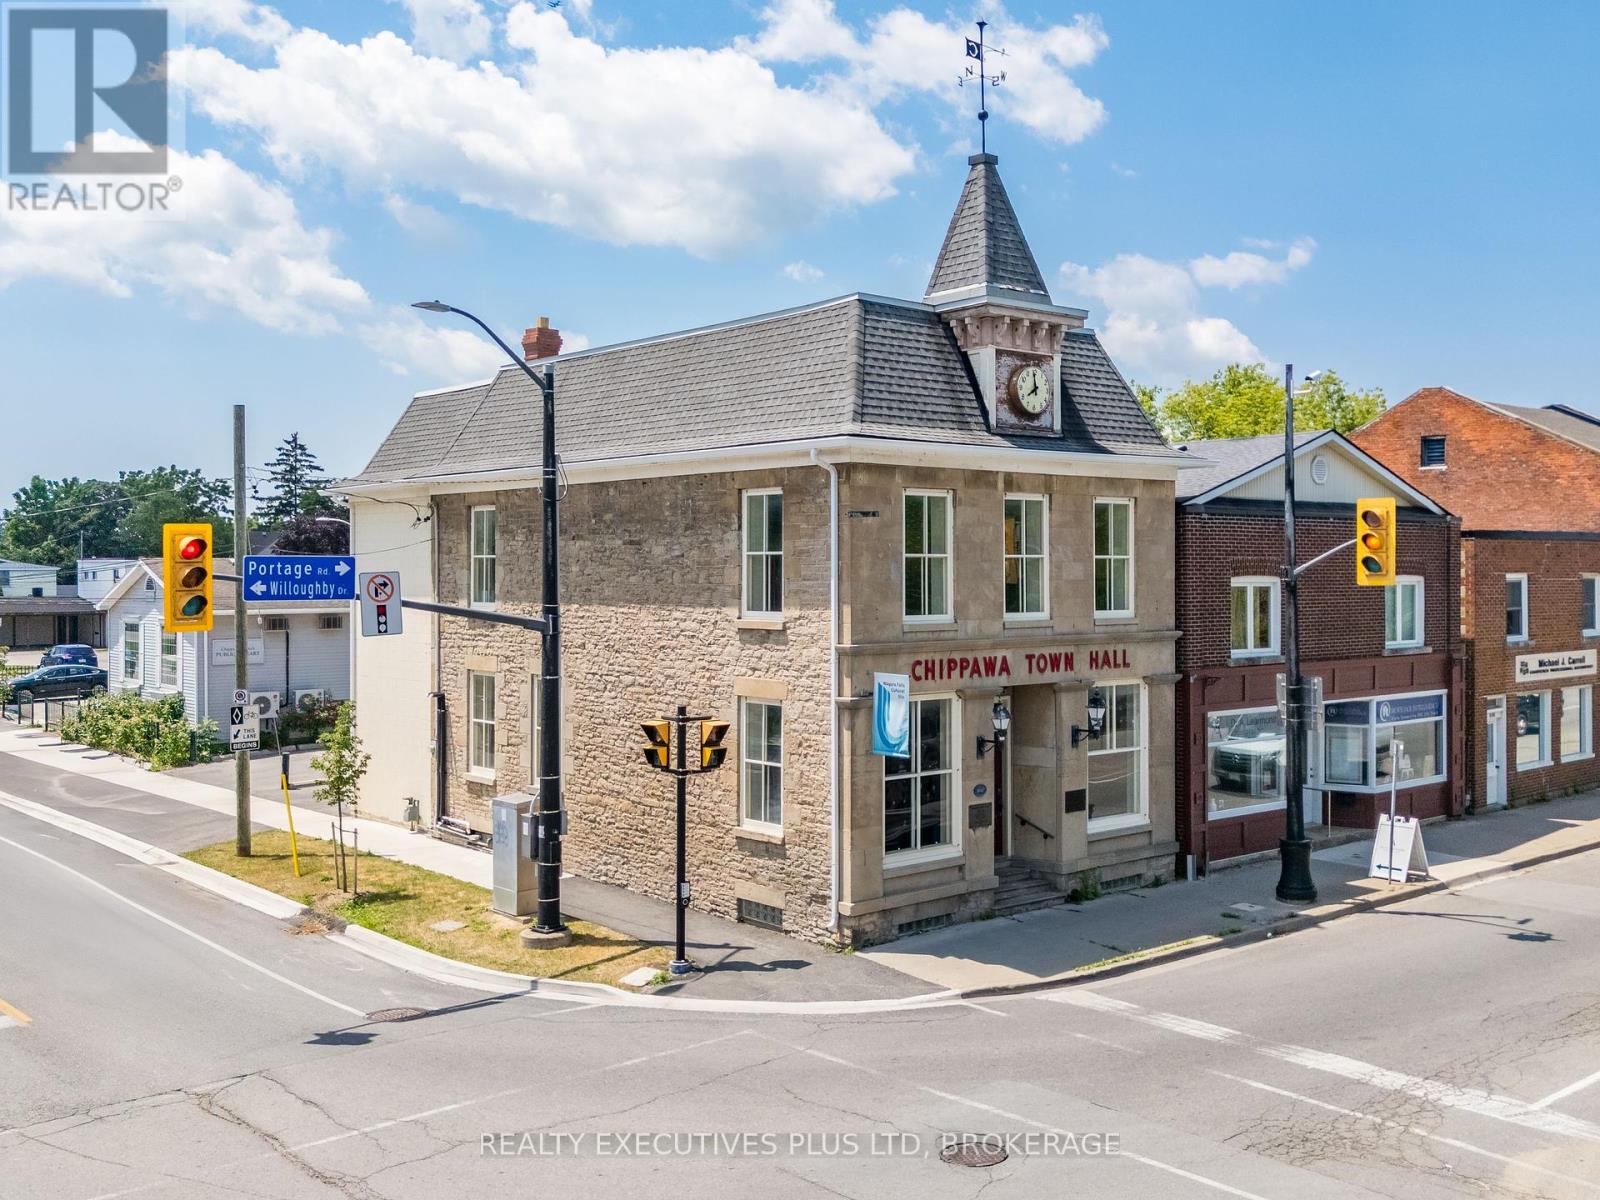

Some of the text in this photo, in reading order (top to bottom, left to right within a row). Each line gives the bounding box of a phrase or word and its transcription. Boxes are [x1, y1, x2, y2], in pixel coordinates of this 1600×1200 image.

[248, 561, 312, 579] Portage
[270, 581, 334, 598] Willoughby
[911, 649, 1131, 682] CHIPPAWA TOWN HALL
